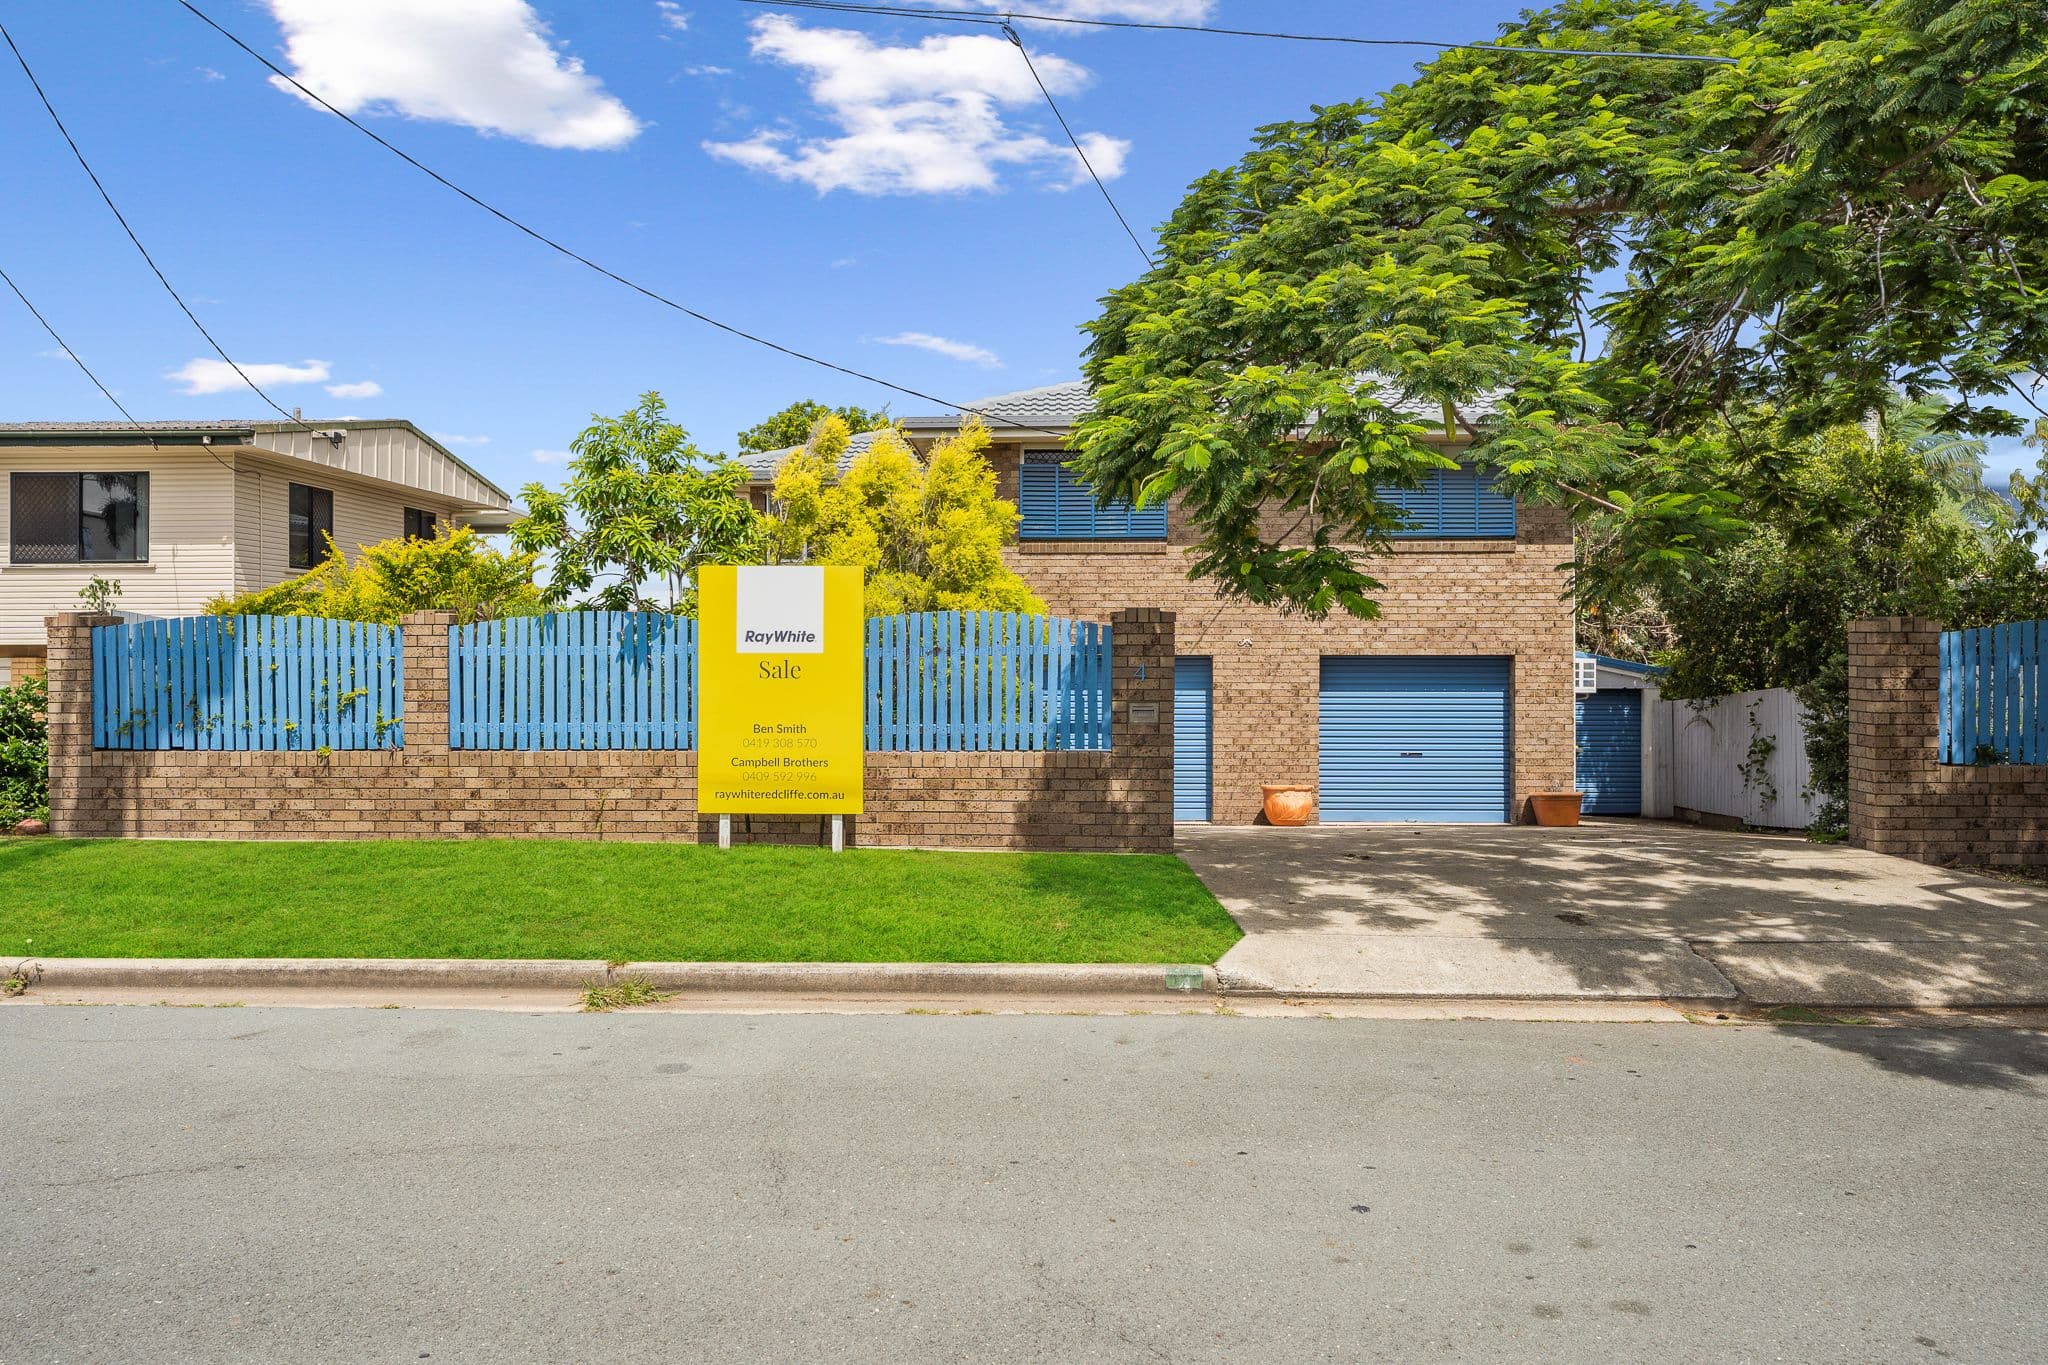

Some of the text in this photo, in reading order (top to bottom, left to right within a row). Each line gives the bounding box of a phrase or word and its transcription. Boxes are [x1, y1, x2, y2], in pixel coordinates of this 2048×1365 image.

[744, 630, 816, 645] RayWhite
[759, 659, 801, 680] Sale
[1134, 662, 1147, 682] 4
[753, 724, 807, 734] Ben Smith
[742, 738, 817, 748] 0419 308 570
[731, 757, 829, 769] Campbell Brothers
[742, 771, 817, 782] 0409 592 996
[714, 789, 845, 801] raywhiteredcliffe.com.au
